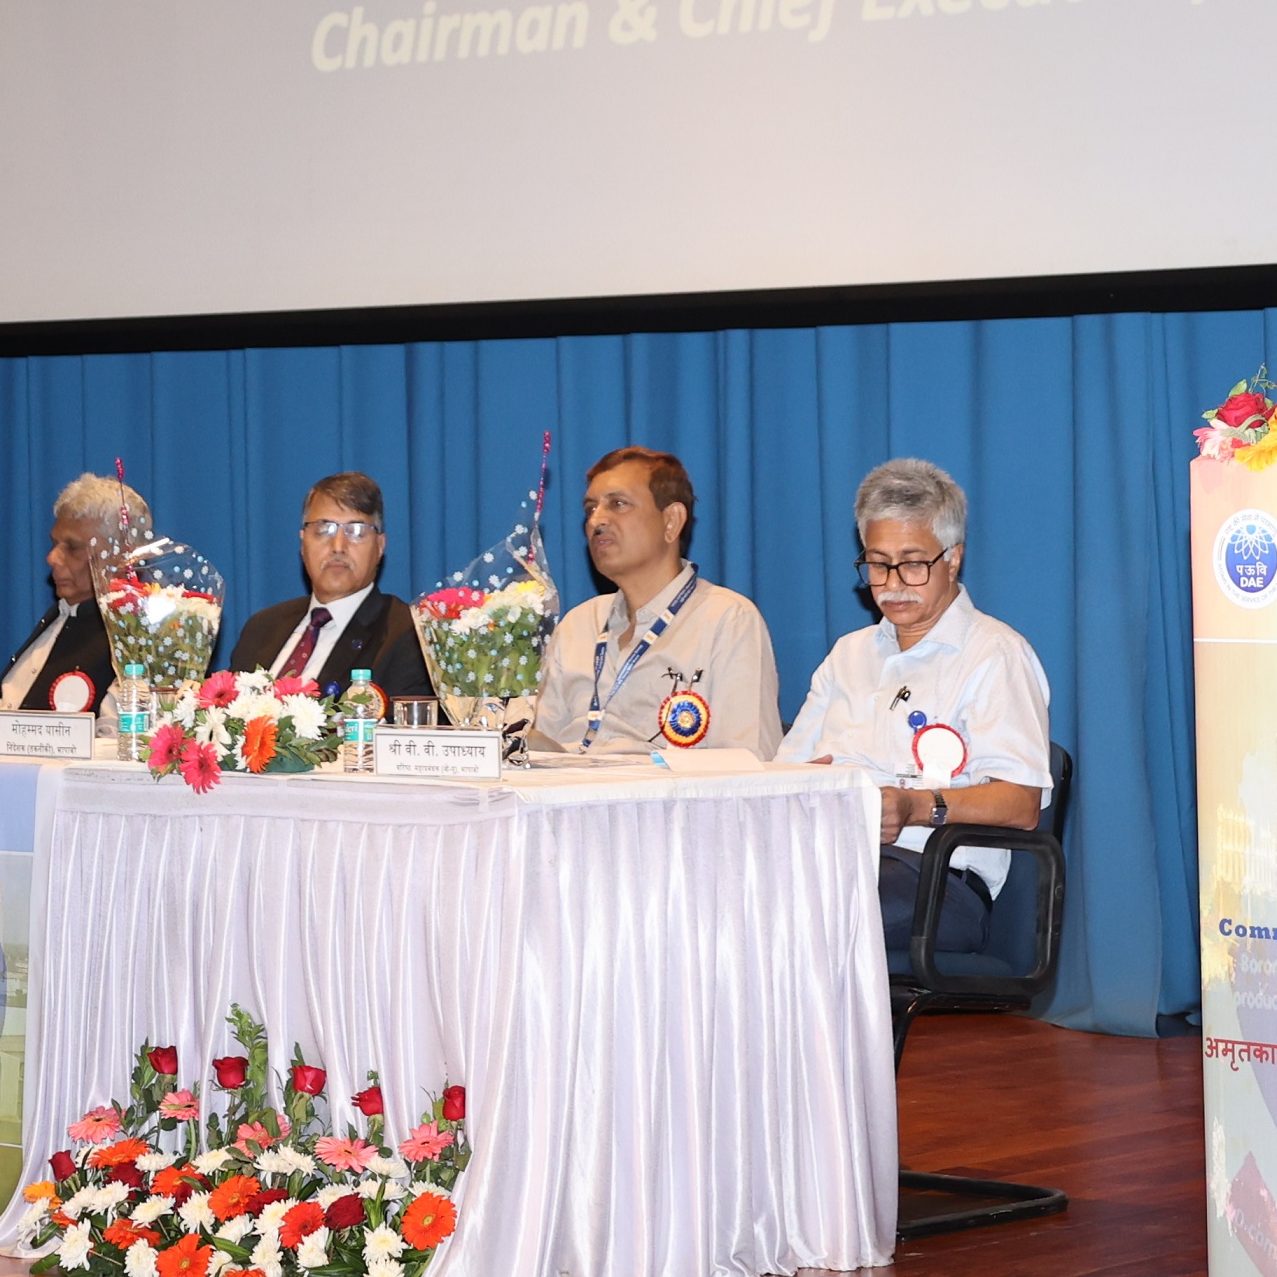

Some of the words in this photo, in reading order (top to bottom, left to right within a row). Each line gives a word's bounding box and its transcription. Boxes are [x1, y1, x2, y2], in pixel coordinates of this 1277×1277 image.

[311, 0, 589, 72] Chairman
[1240, 576, 1264, 588] DAE
[11, 720, 43, 738] मोहम्मद
[45, 721, 71, 737] यासीन
[389, 739, 402, 756] श्री
[442, 745, 486, 757] उपाध्याय
